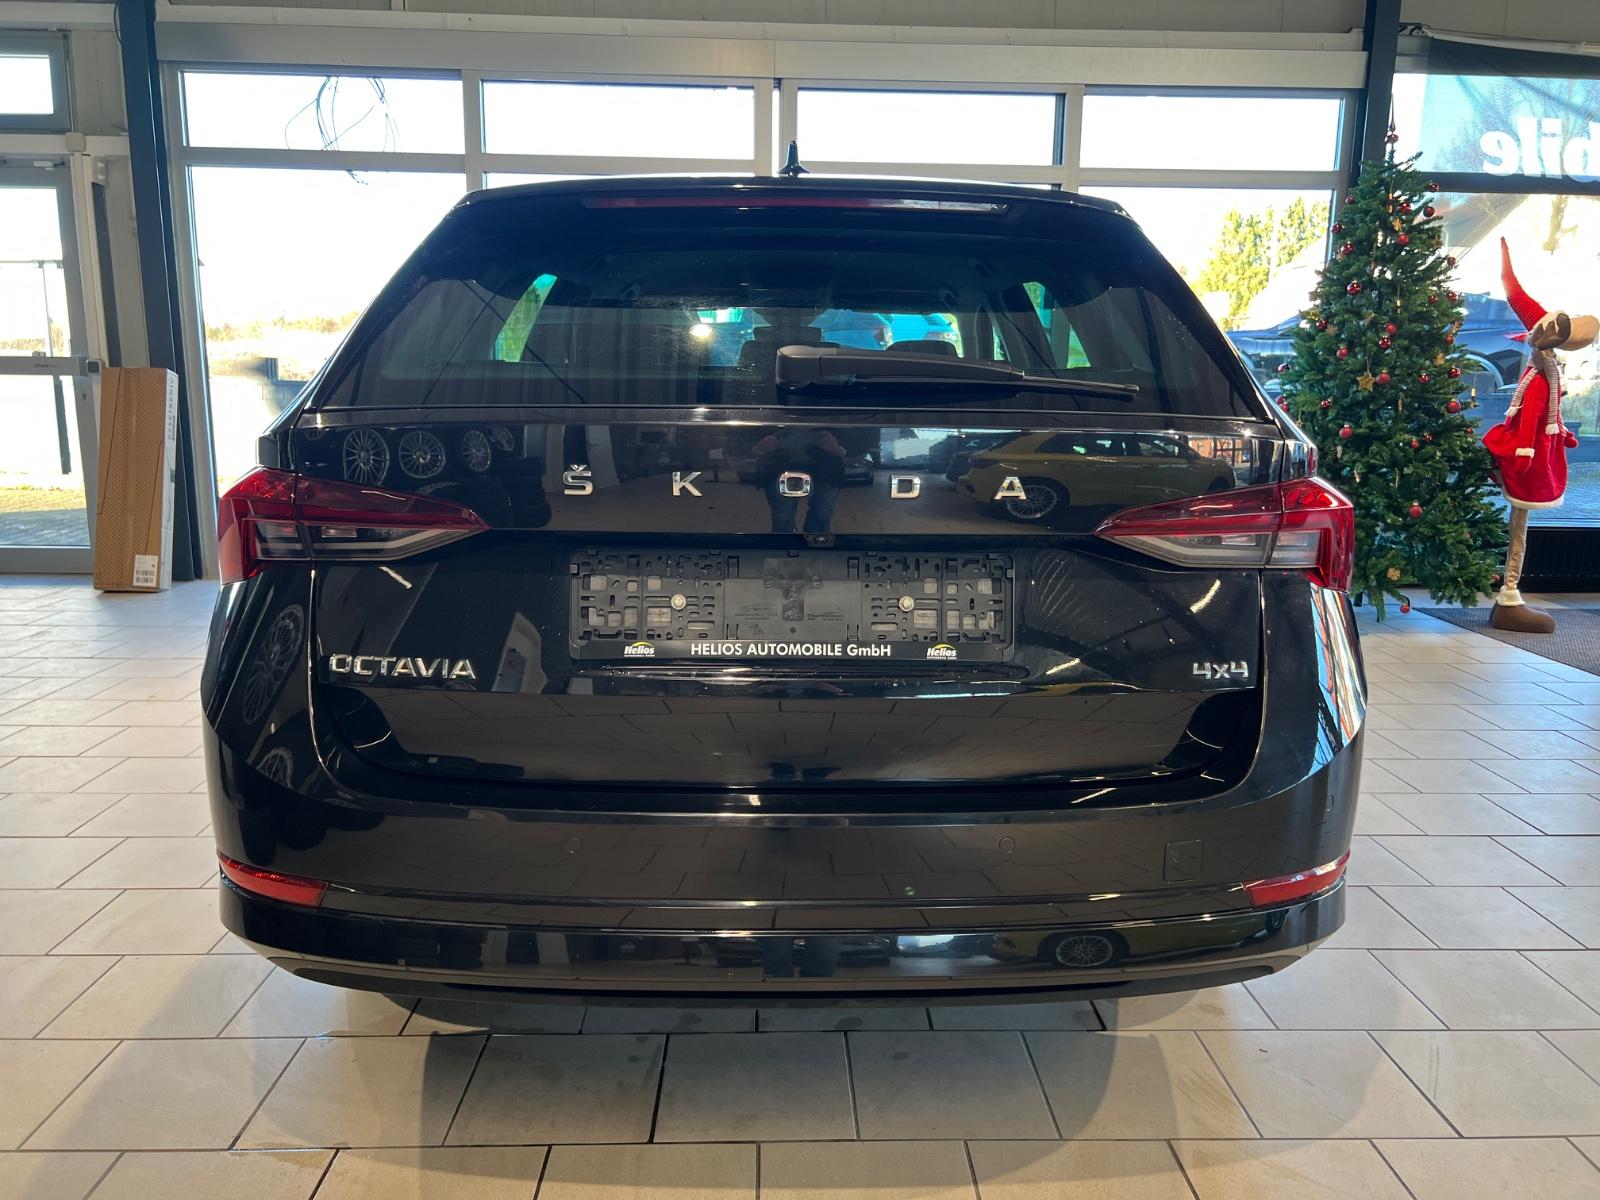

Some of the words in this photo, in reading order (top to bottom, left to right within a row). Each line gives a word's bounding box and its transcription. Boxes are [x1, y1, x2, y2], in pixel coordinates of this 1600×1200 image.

[563, 464, 1027, 500] ŠKODA
[624, 645, 655, 655] Helios
[691, 643, 743, 656] HELIOS
[746, 643, 842, 656] AUTOMOBILE
[846, 644, 891, 657] GmbH
[927, 648, 957, 657] Helios
[329, 653, 477, 680] OCTAVIA
[1192, 661, 1249, 680] 4x4
